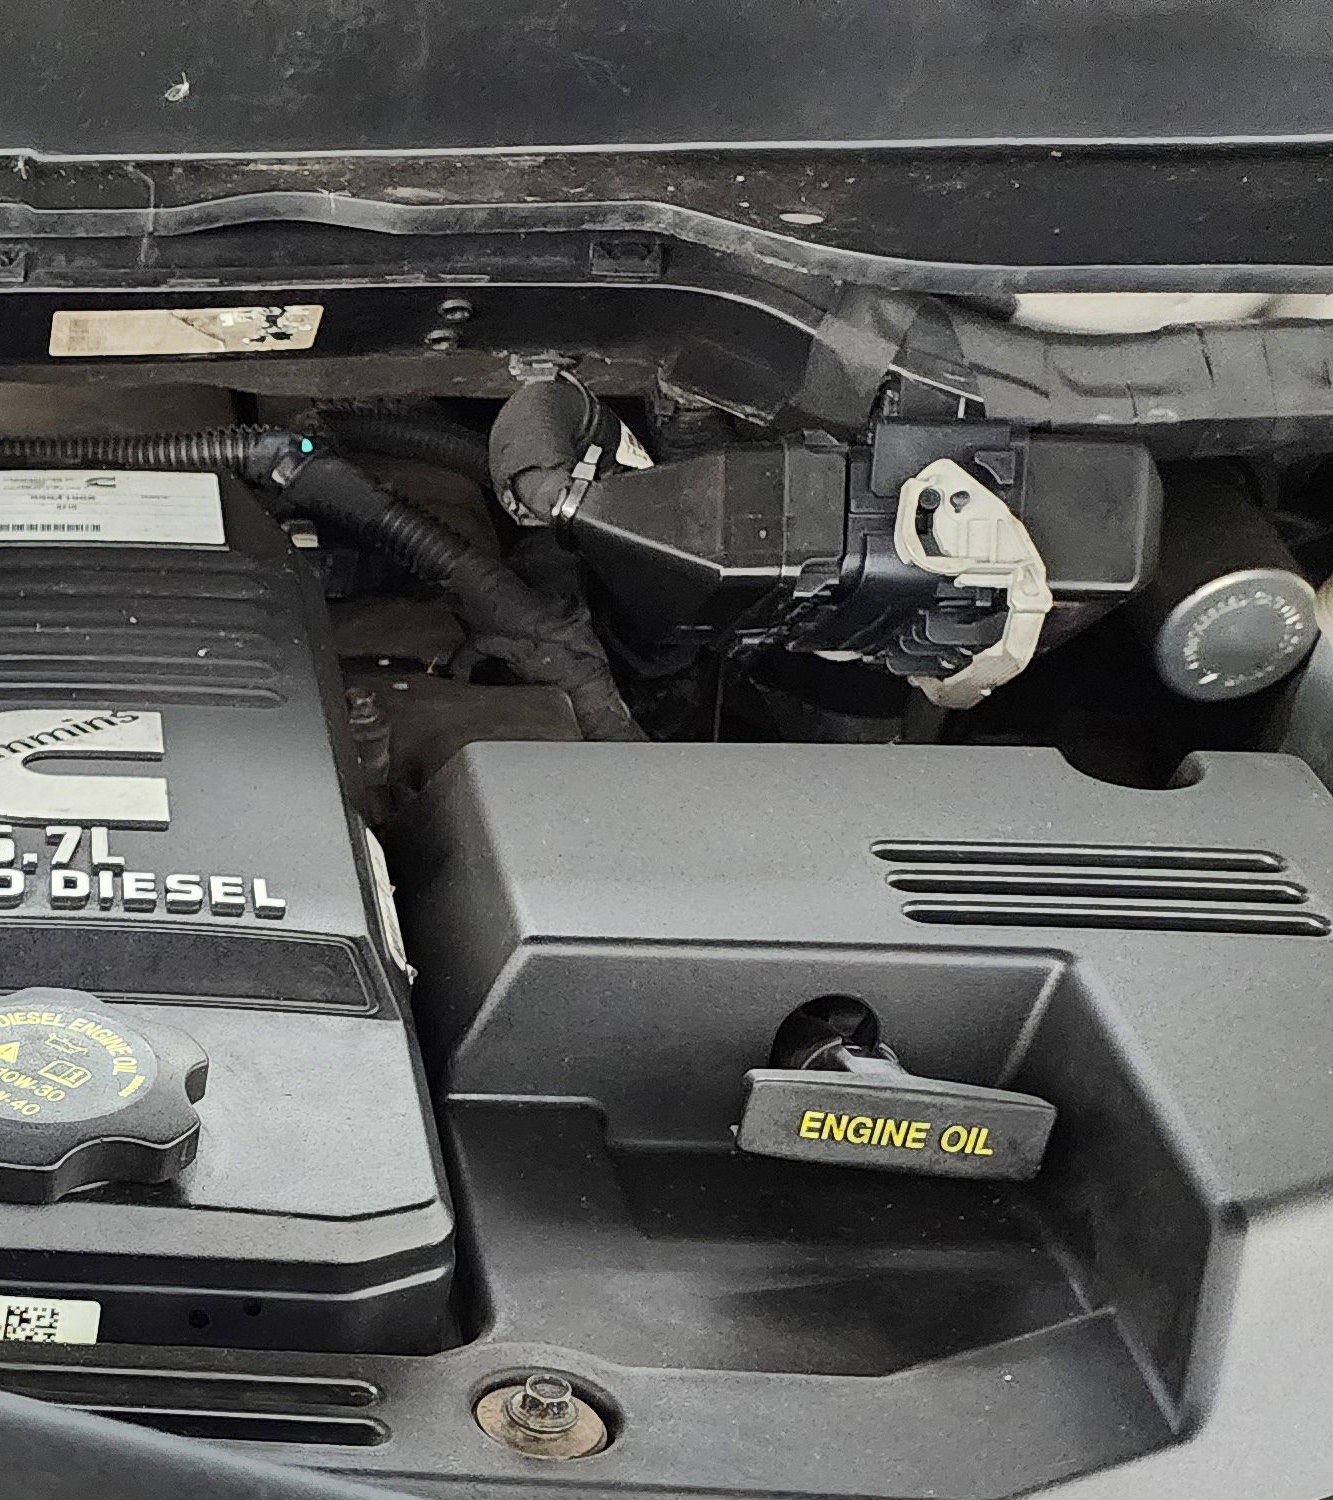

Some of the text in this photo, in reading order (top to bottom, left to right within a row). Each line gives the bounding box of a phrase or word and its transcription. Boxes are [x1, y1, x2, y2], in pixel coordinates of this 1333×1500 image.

[50, 869, 288, 914] DIESEL
[68, 1017, 133, 1058] ENGINE
[112, 1056, 138, 1076] OIL
[799, 1109, 995, 1156] ENGINE OIL
